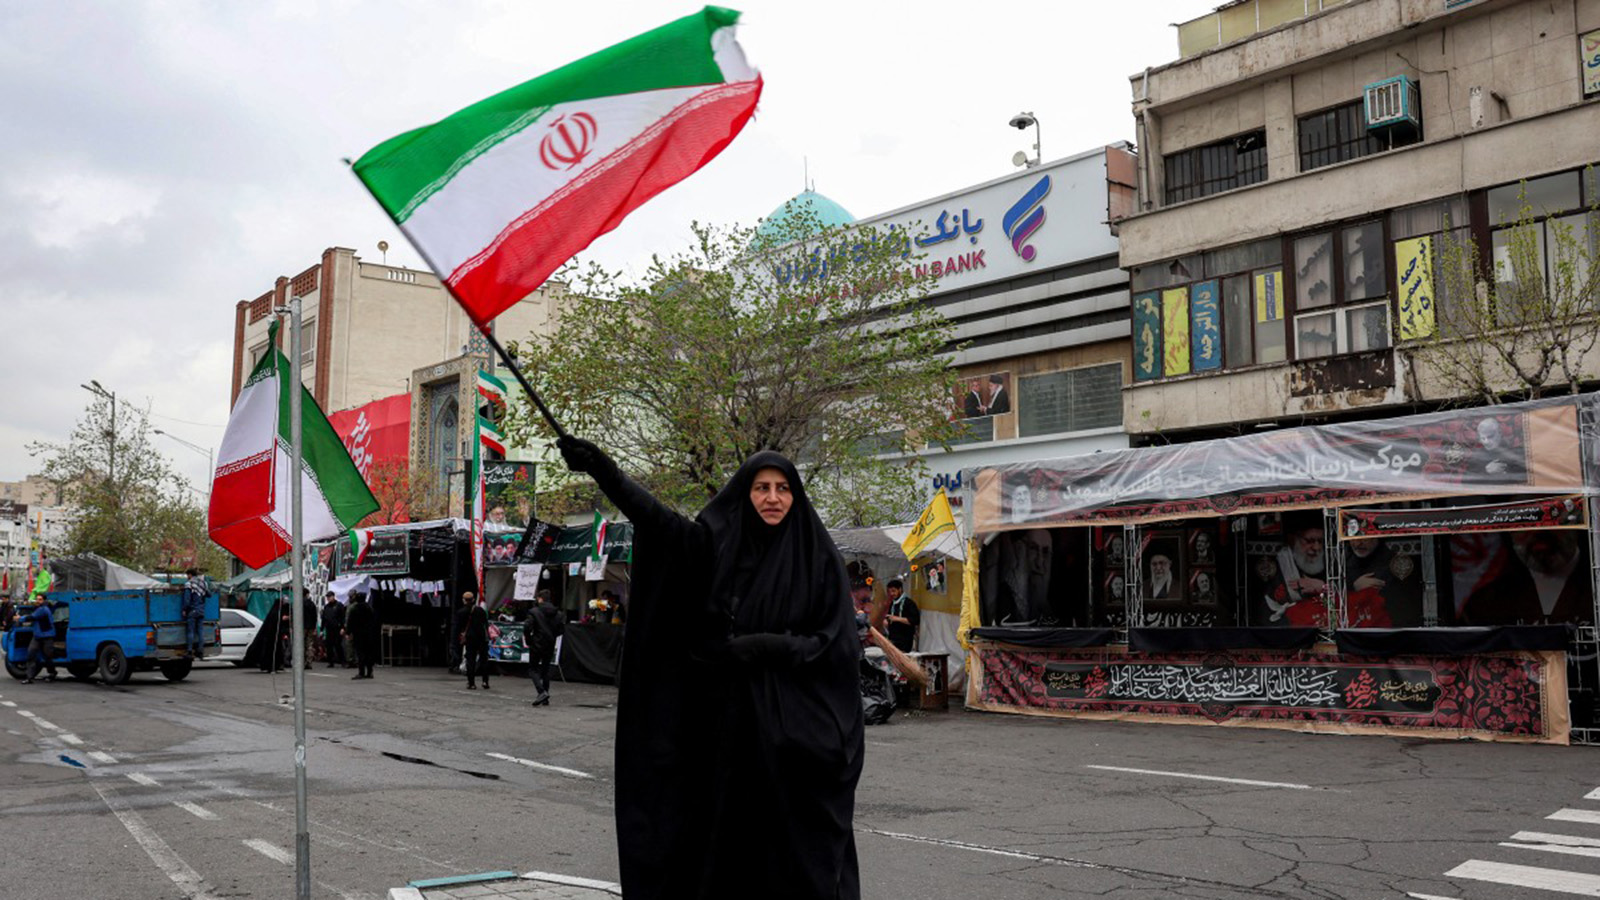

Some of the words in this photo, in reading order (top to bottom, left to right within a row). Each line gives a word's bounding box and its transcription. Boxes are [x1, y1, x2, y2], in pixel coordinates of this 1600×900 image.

[914, 208, 983, 248] بانک
[932, 249, 986, 278] BANK
[1353, 444, 1421, 480] موکب
